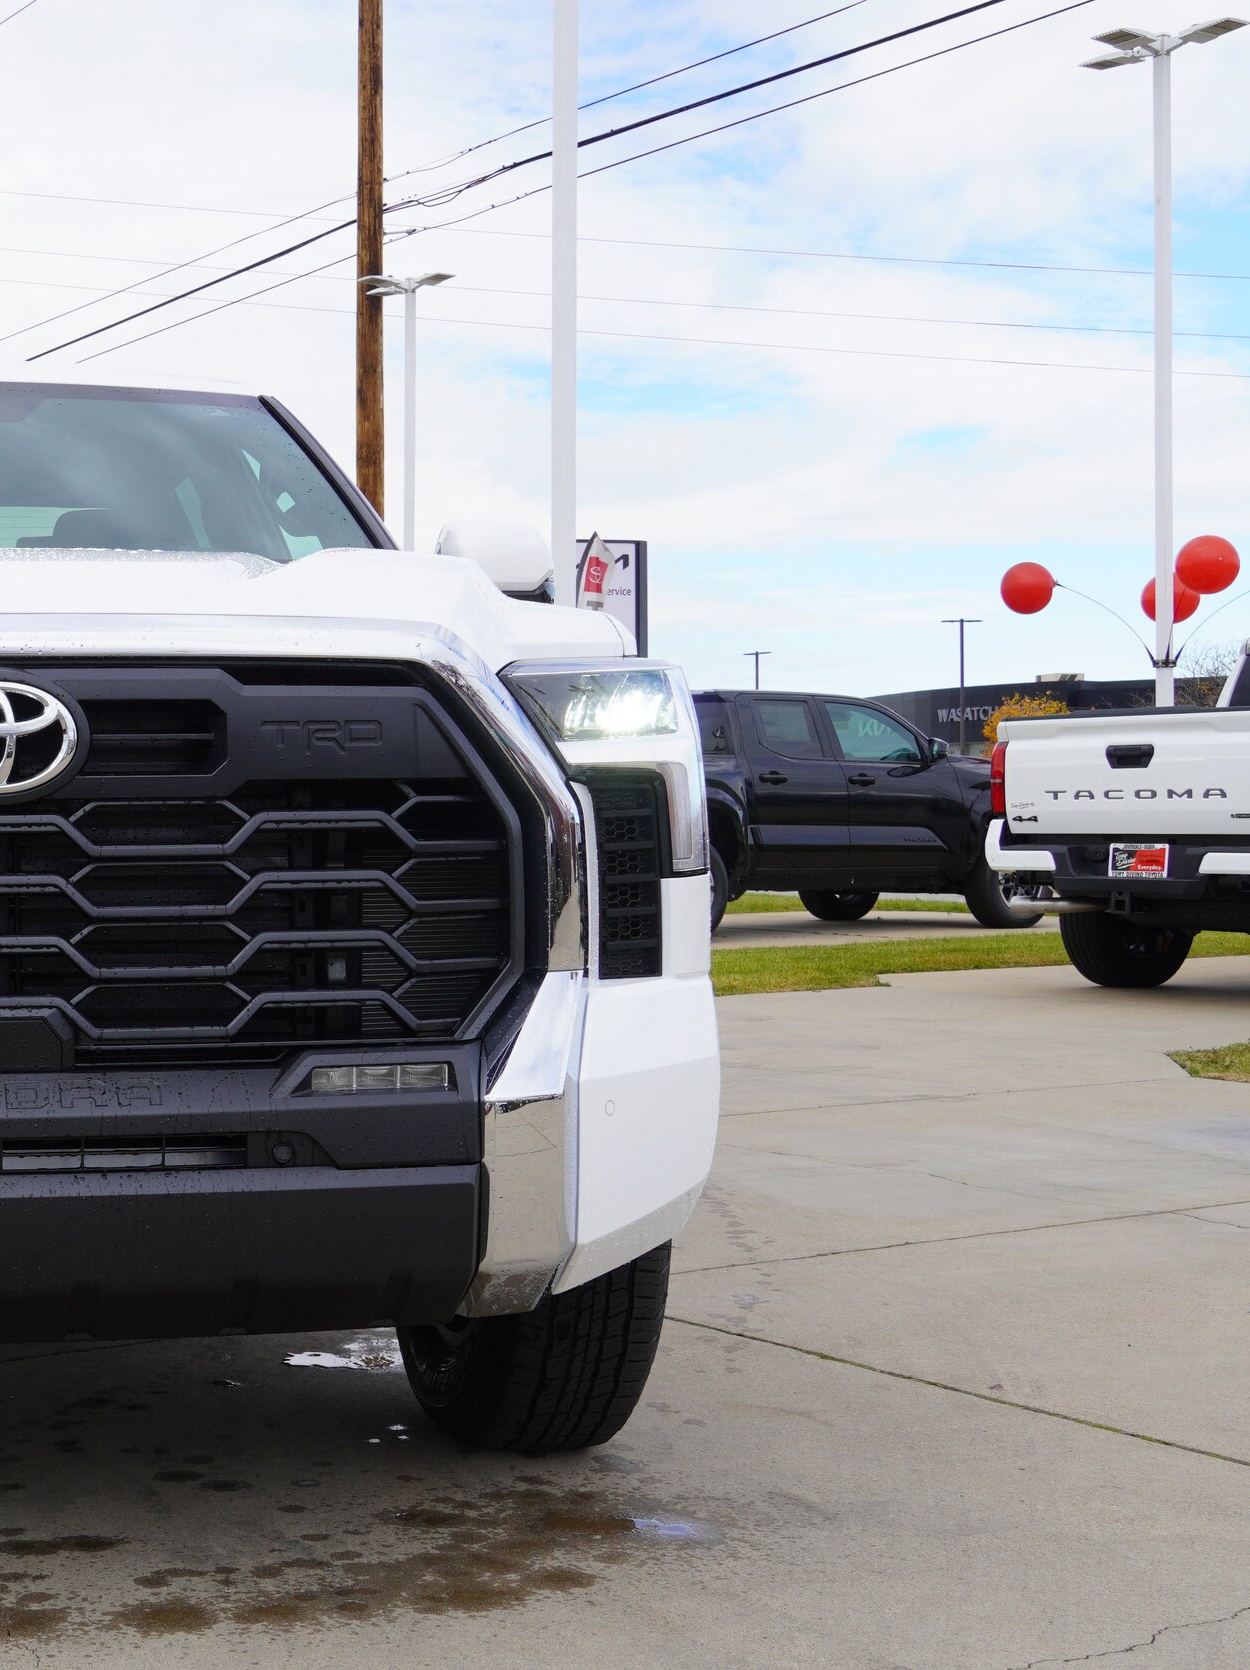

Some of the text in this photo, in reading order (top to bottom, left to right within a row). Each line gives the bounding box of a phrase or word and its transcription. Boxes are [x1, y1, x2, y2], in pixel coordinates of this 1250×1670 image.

[607, 587, 632, 596] ervice
[937, 706, 999, 723] WASATCH
[260, 719, 383, 756] TRD
[1043, 788, 1228, 800] TACOMA
